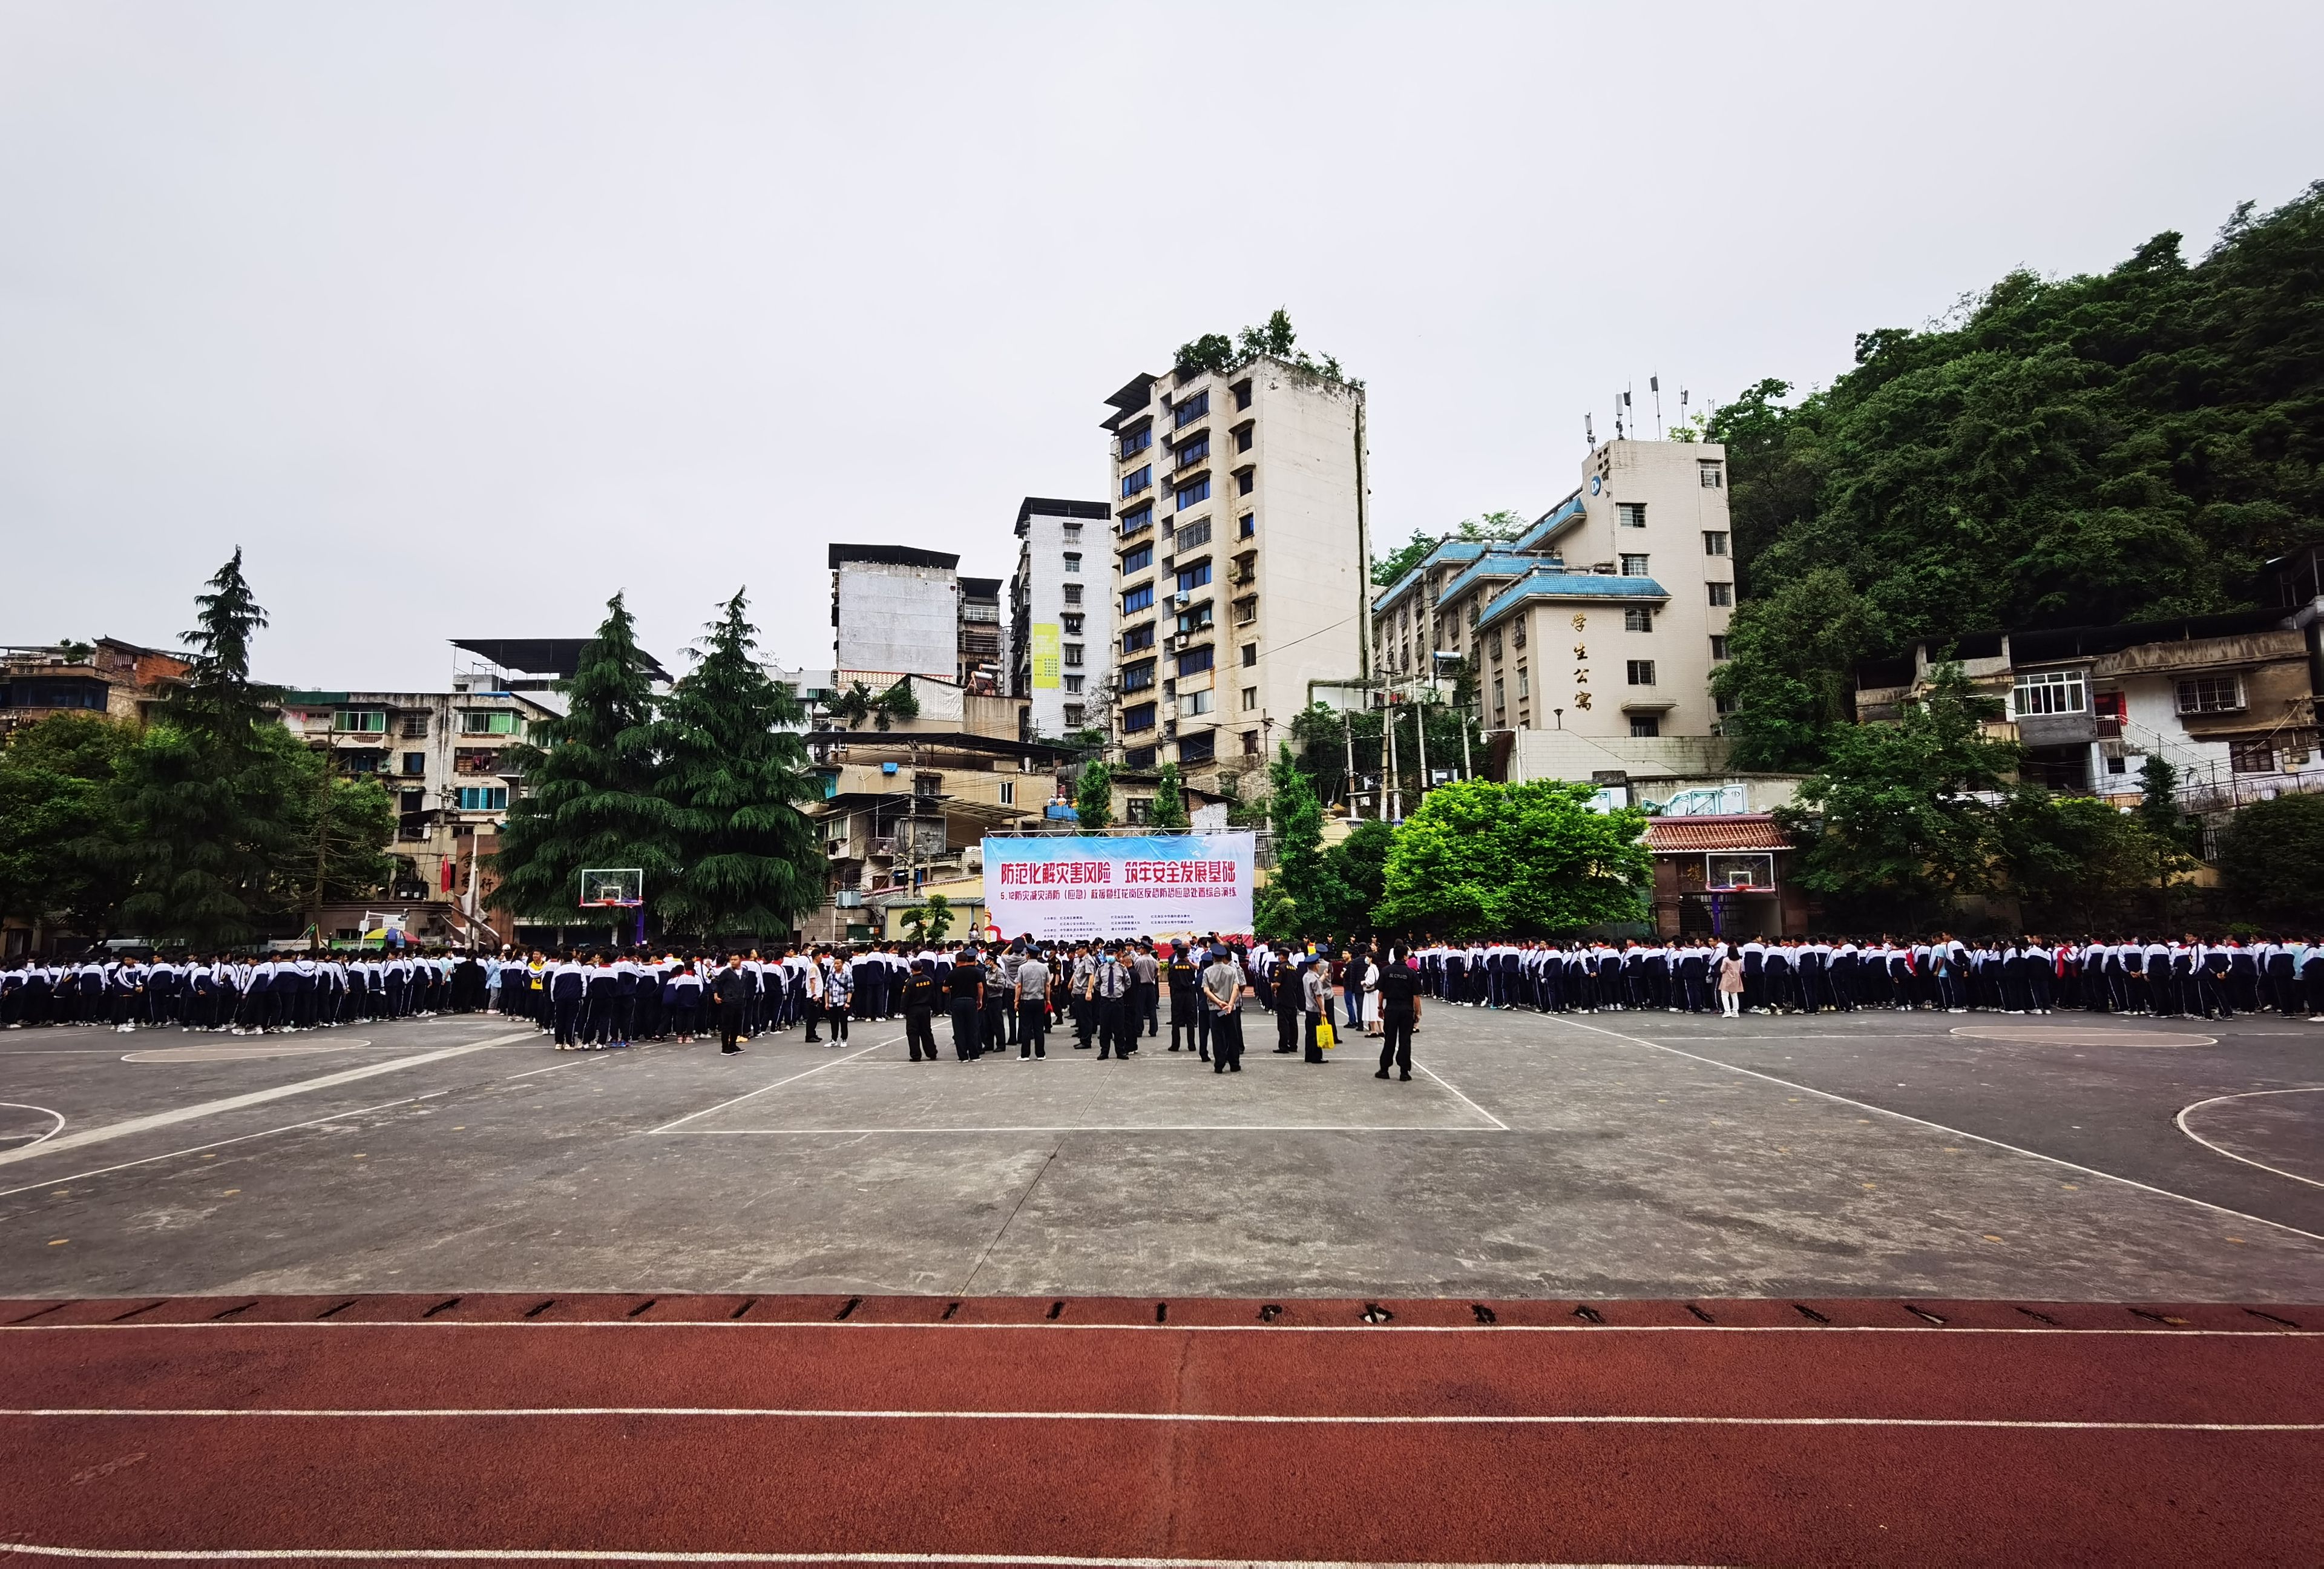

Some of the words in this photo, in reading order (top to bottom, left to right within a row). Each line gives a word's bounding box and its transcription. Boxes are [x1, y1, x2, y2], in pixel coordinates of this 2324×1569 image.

[1571, 612, 1592, 711] 学生公寓
[1001, 861, 1111, 885] 防范化解灾害风险
[1125, 860, 1236, 883] 筑牢安全发展基础
